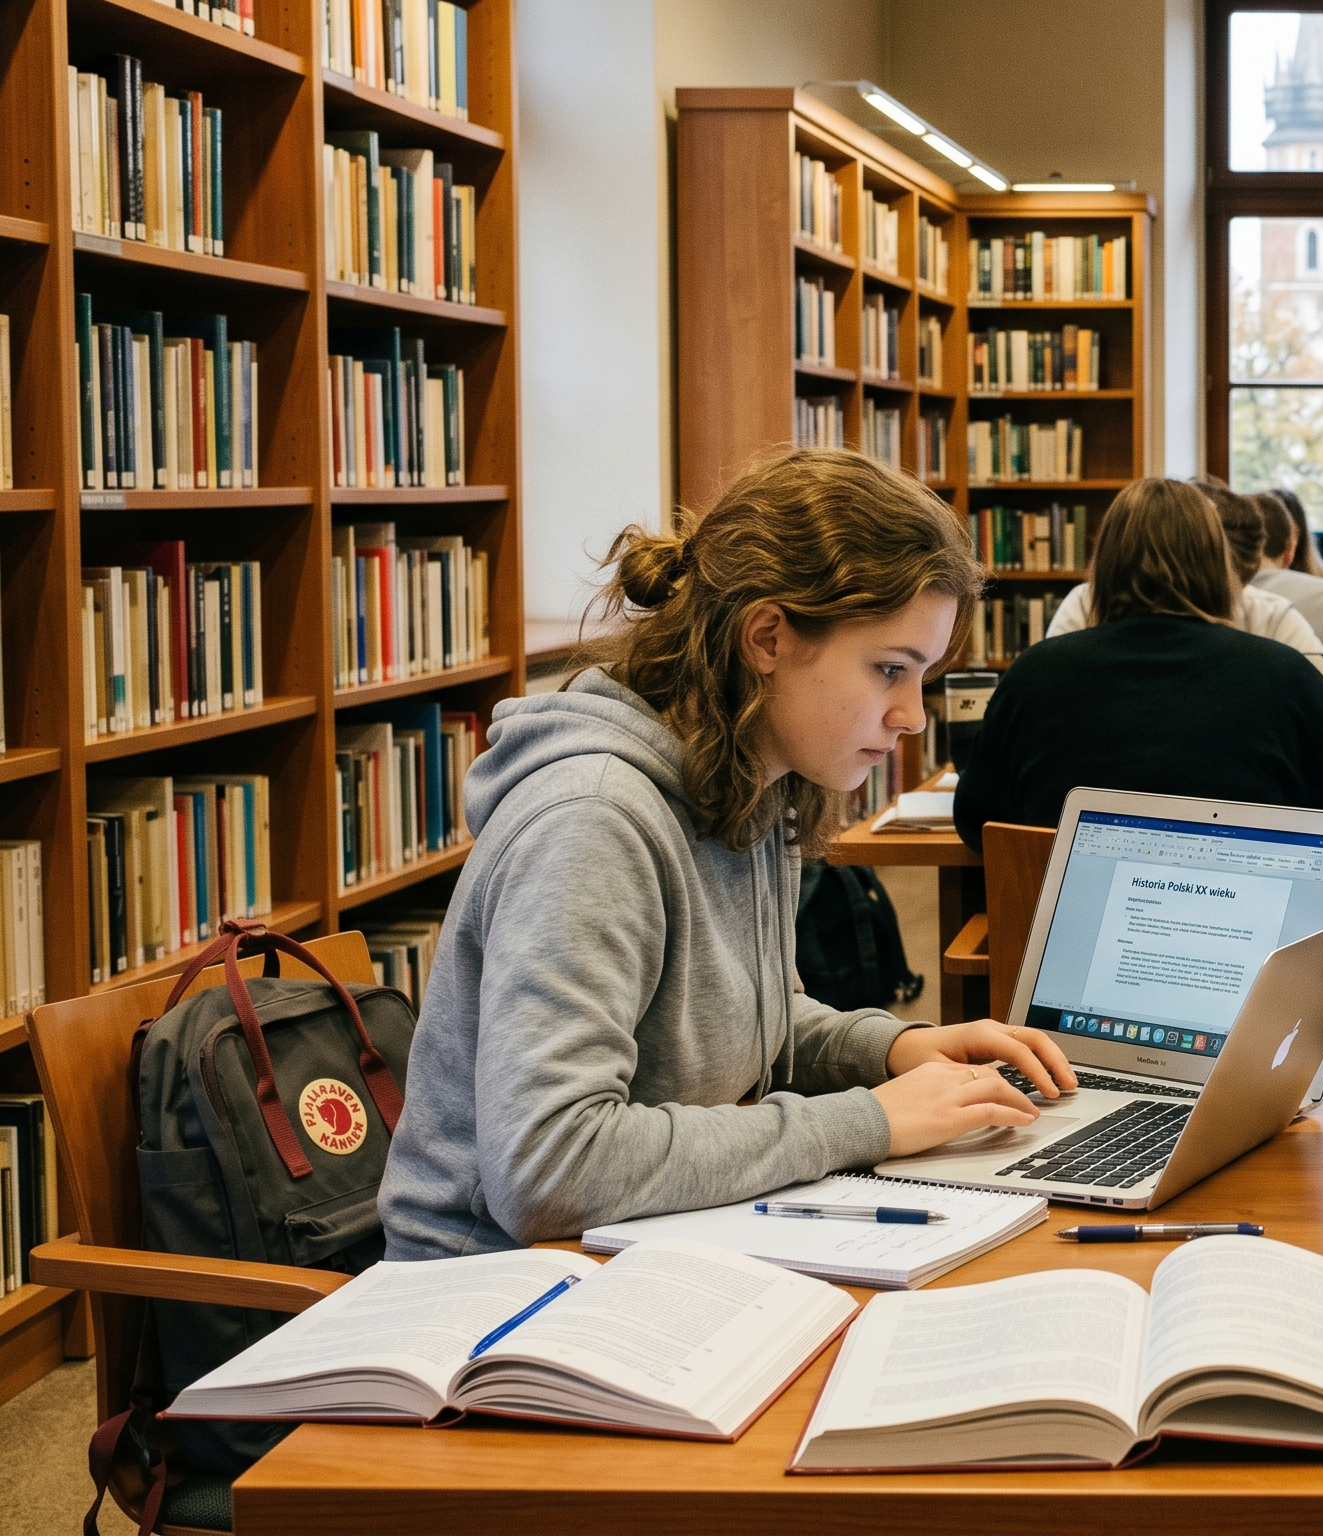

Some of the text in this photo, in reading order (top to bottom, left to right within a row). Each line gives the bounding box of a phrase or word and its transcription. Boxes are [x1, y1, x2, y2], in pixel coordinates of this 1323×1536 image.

[1131, 877, 1237, 899] Historia Polski XX wieku
